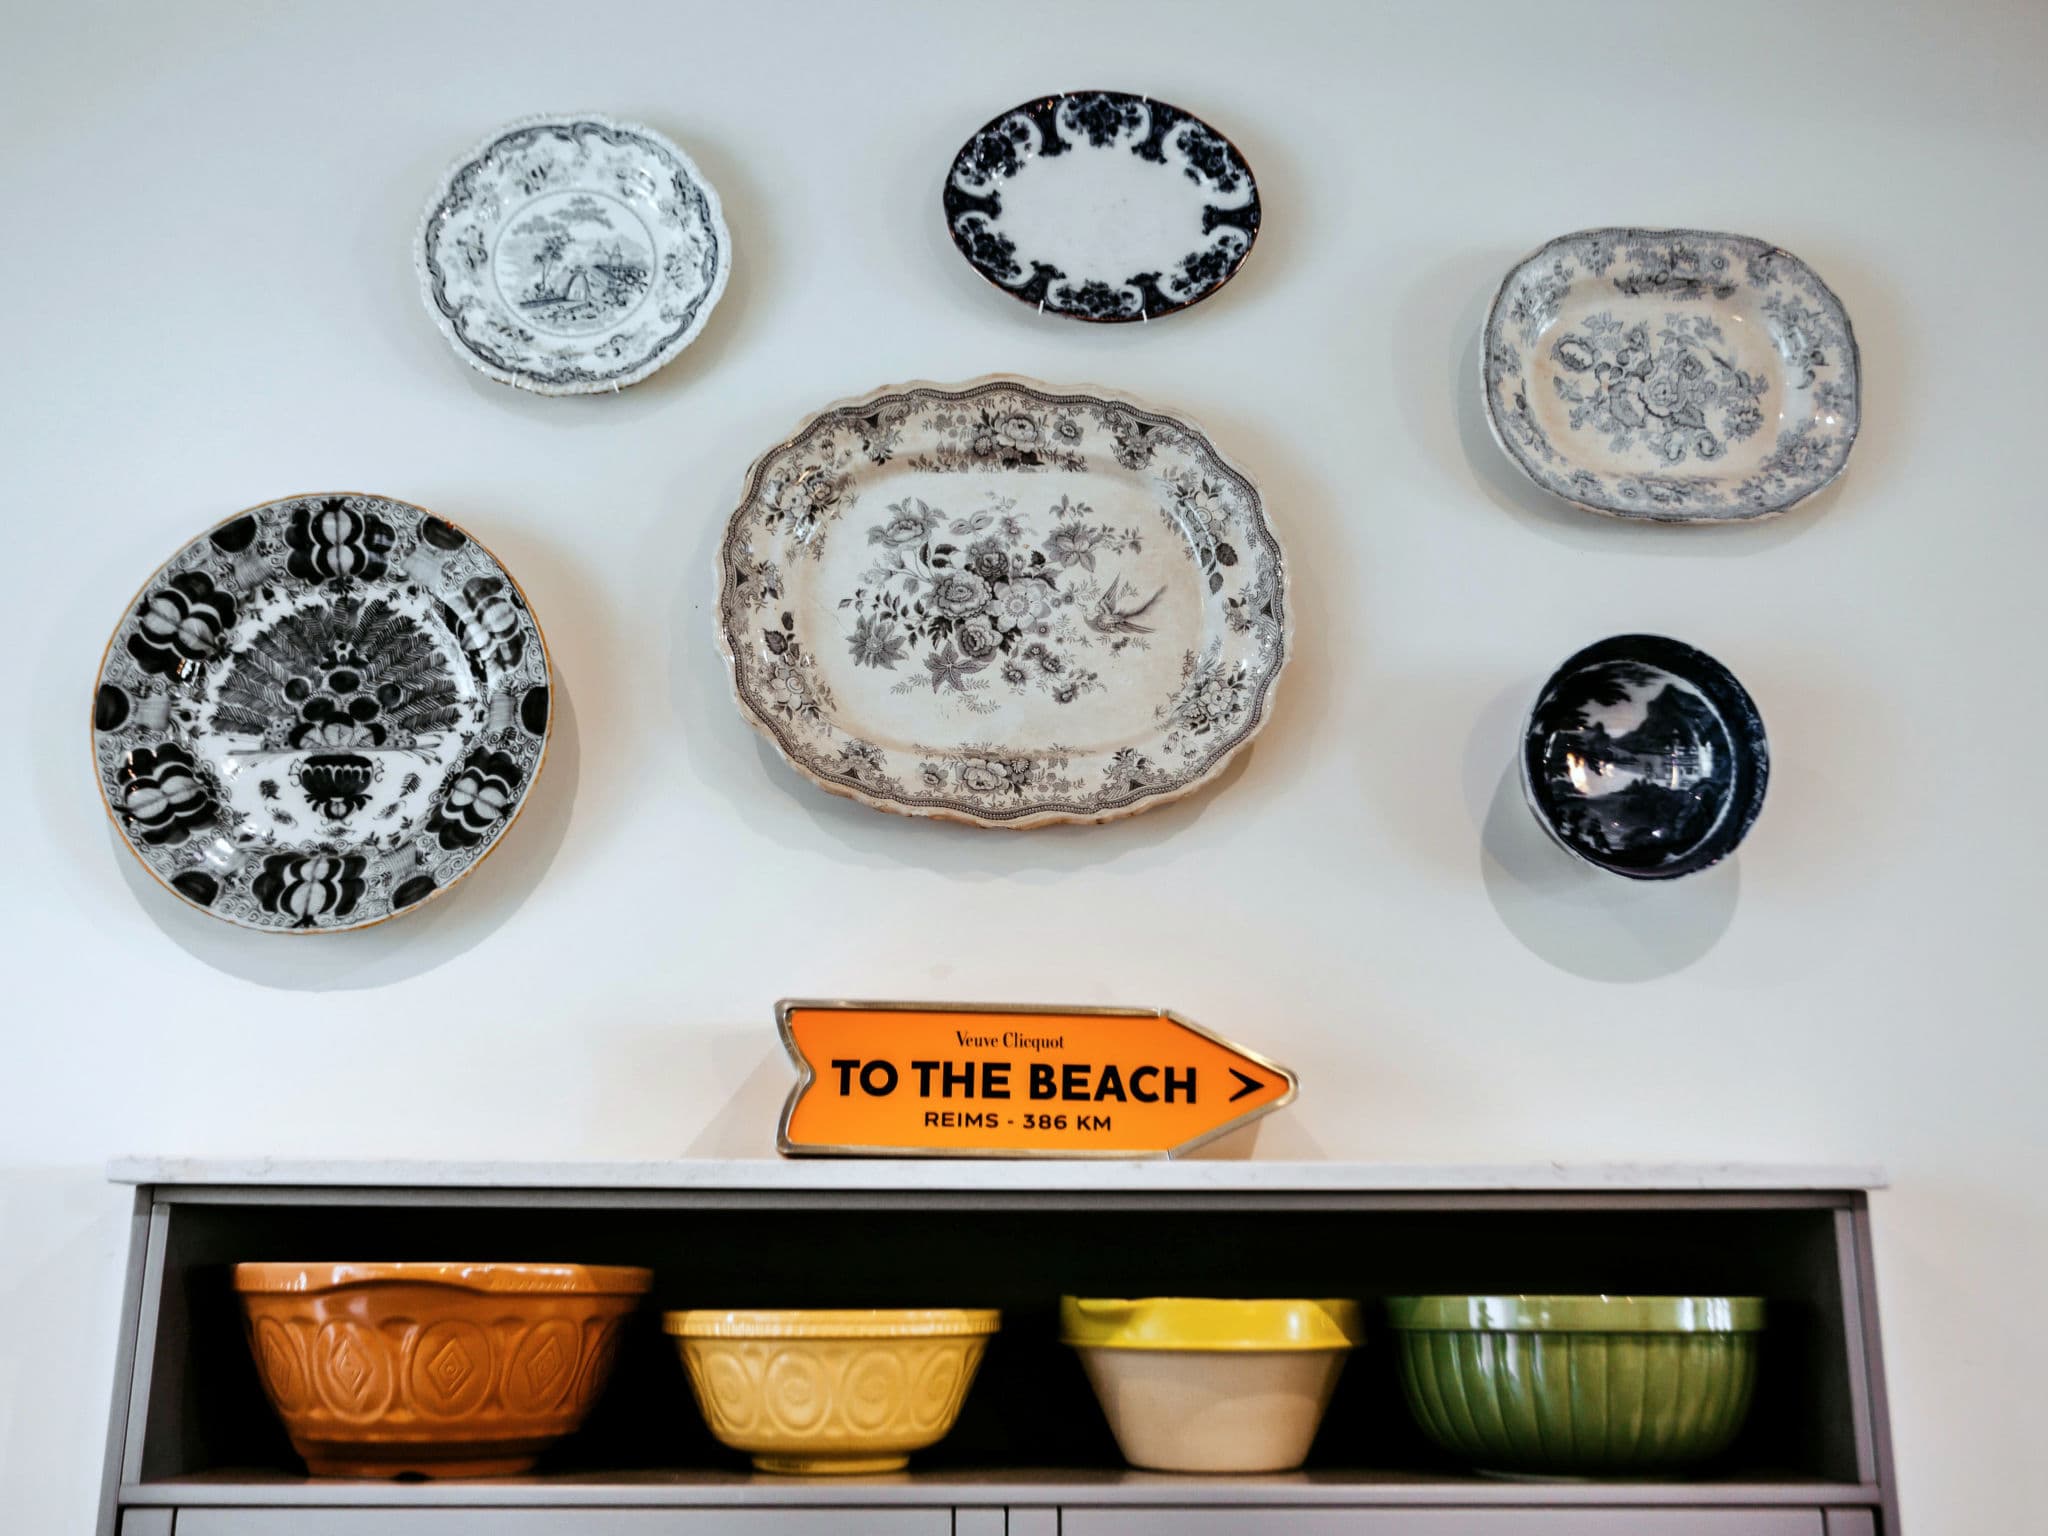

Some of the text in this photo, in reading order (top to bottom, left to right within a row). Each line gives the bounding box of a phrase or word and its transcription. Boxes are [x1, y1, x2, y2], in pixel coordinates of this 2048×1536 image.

[956, 1030, 1065, 1053] Veuve Clicquot
[832, 1059, 1197, 1104] TO THE BEACH
[924, 1111, 999, 1129] REIMS
[1023, 1113, 1068, 1130] 386
[1077, 1115, 1112, 1131] KM
